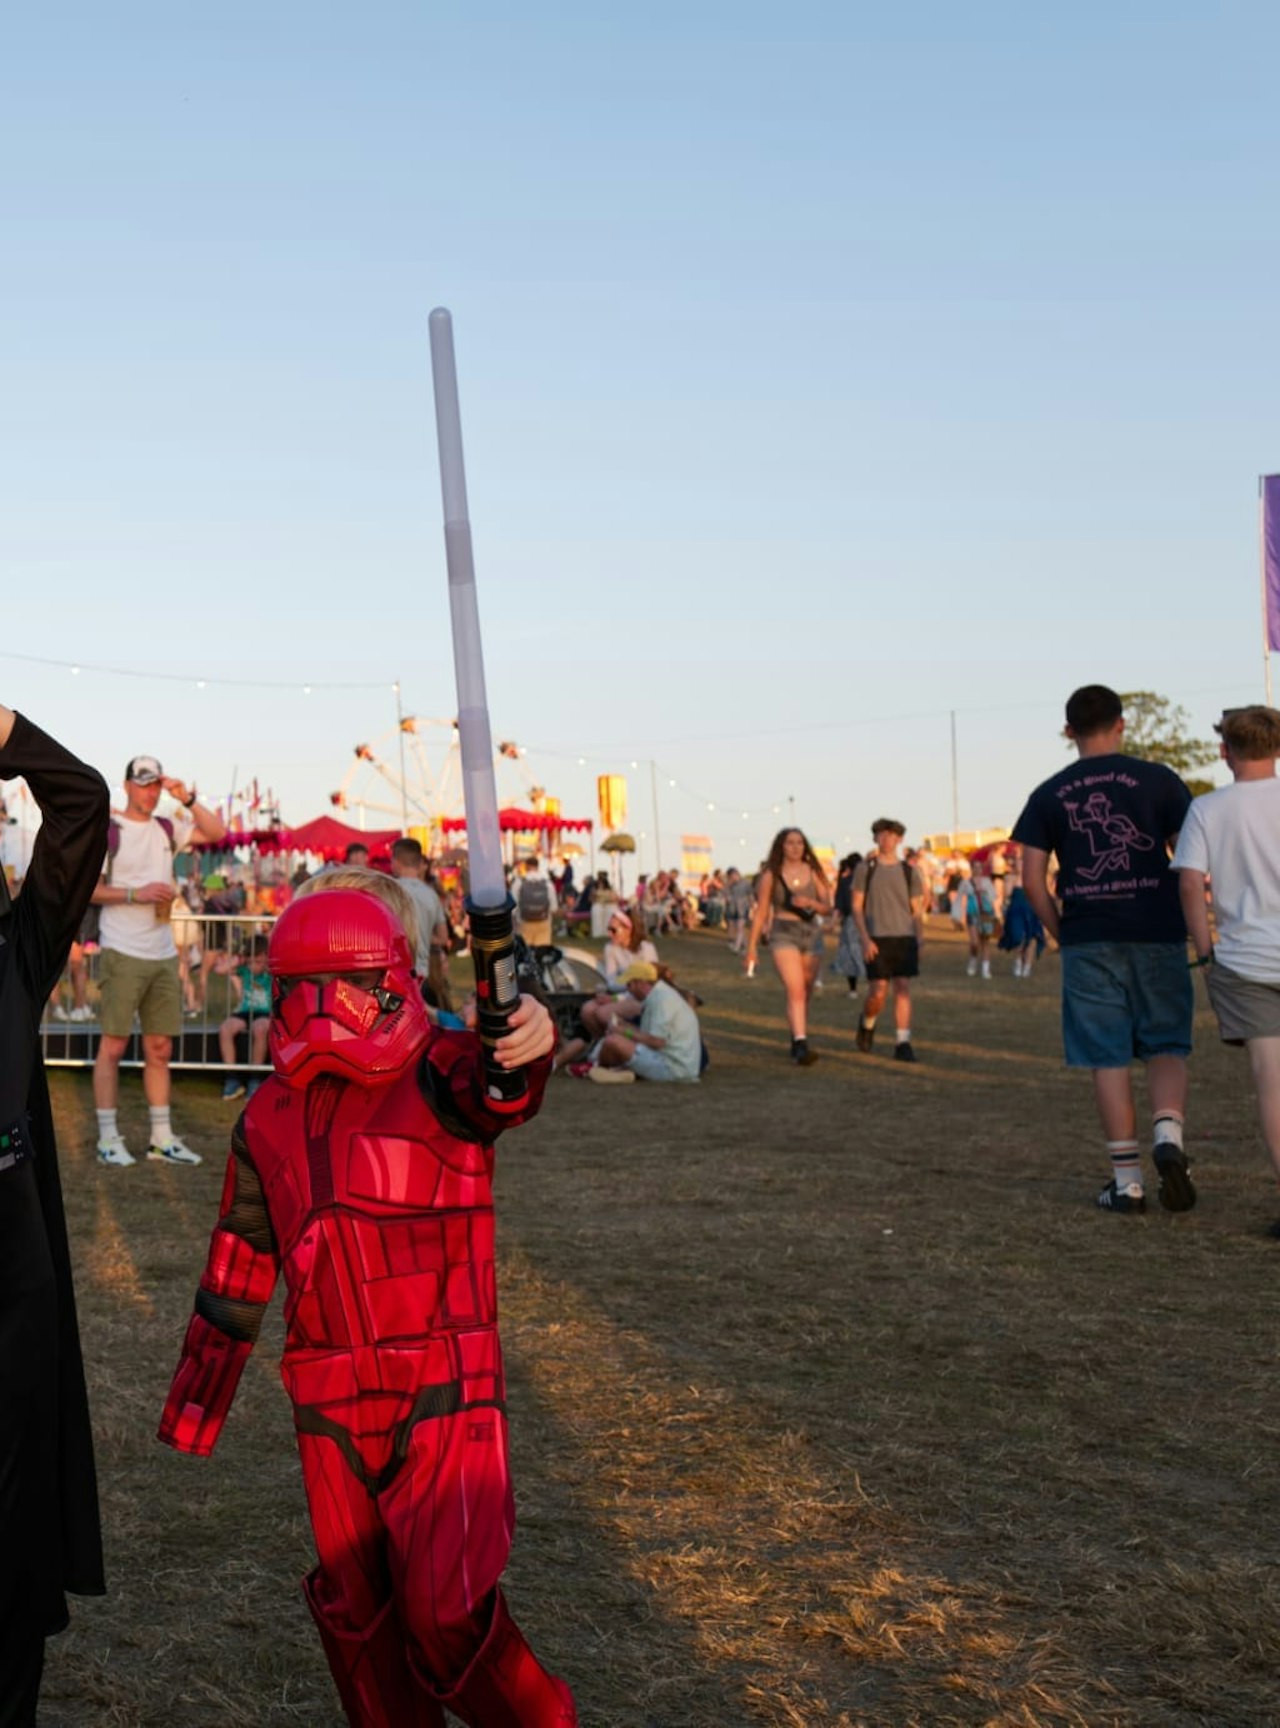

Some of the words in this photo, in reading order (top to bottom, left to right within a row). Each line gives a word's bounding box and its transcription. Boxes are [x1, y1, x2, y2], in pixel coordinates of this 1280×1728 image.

[1083, 771, 1114, 786] good
[1116, 772, 1140, 788] day
[1073, 883, 1100, 895] have
[1110, 877, 1137, 892] good
[1138, 877, 1159, 889] day
